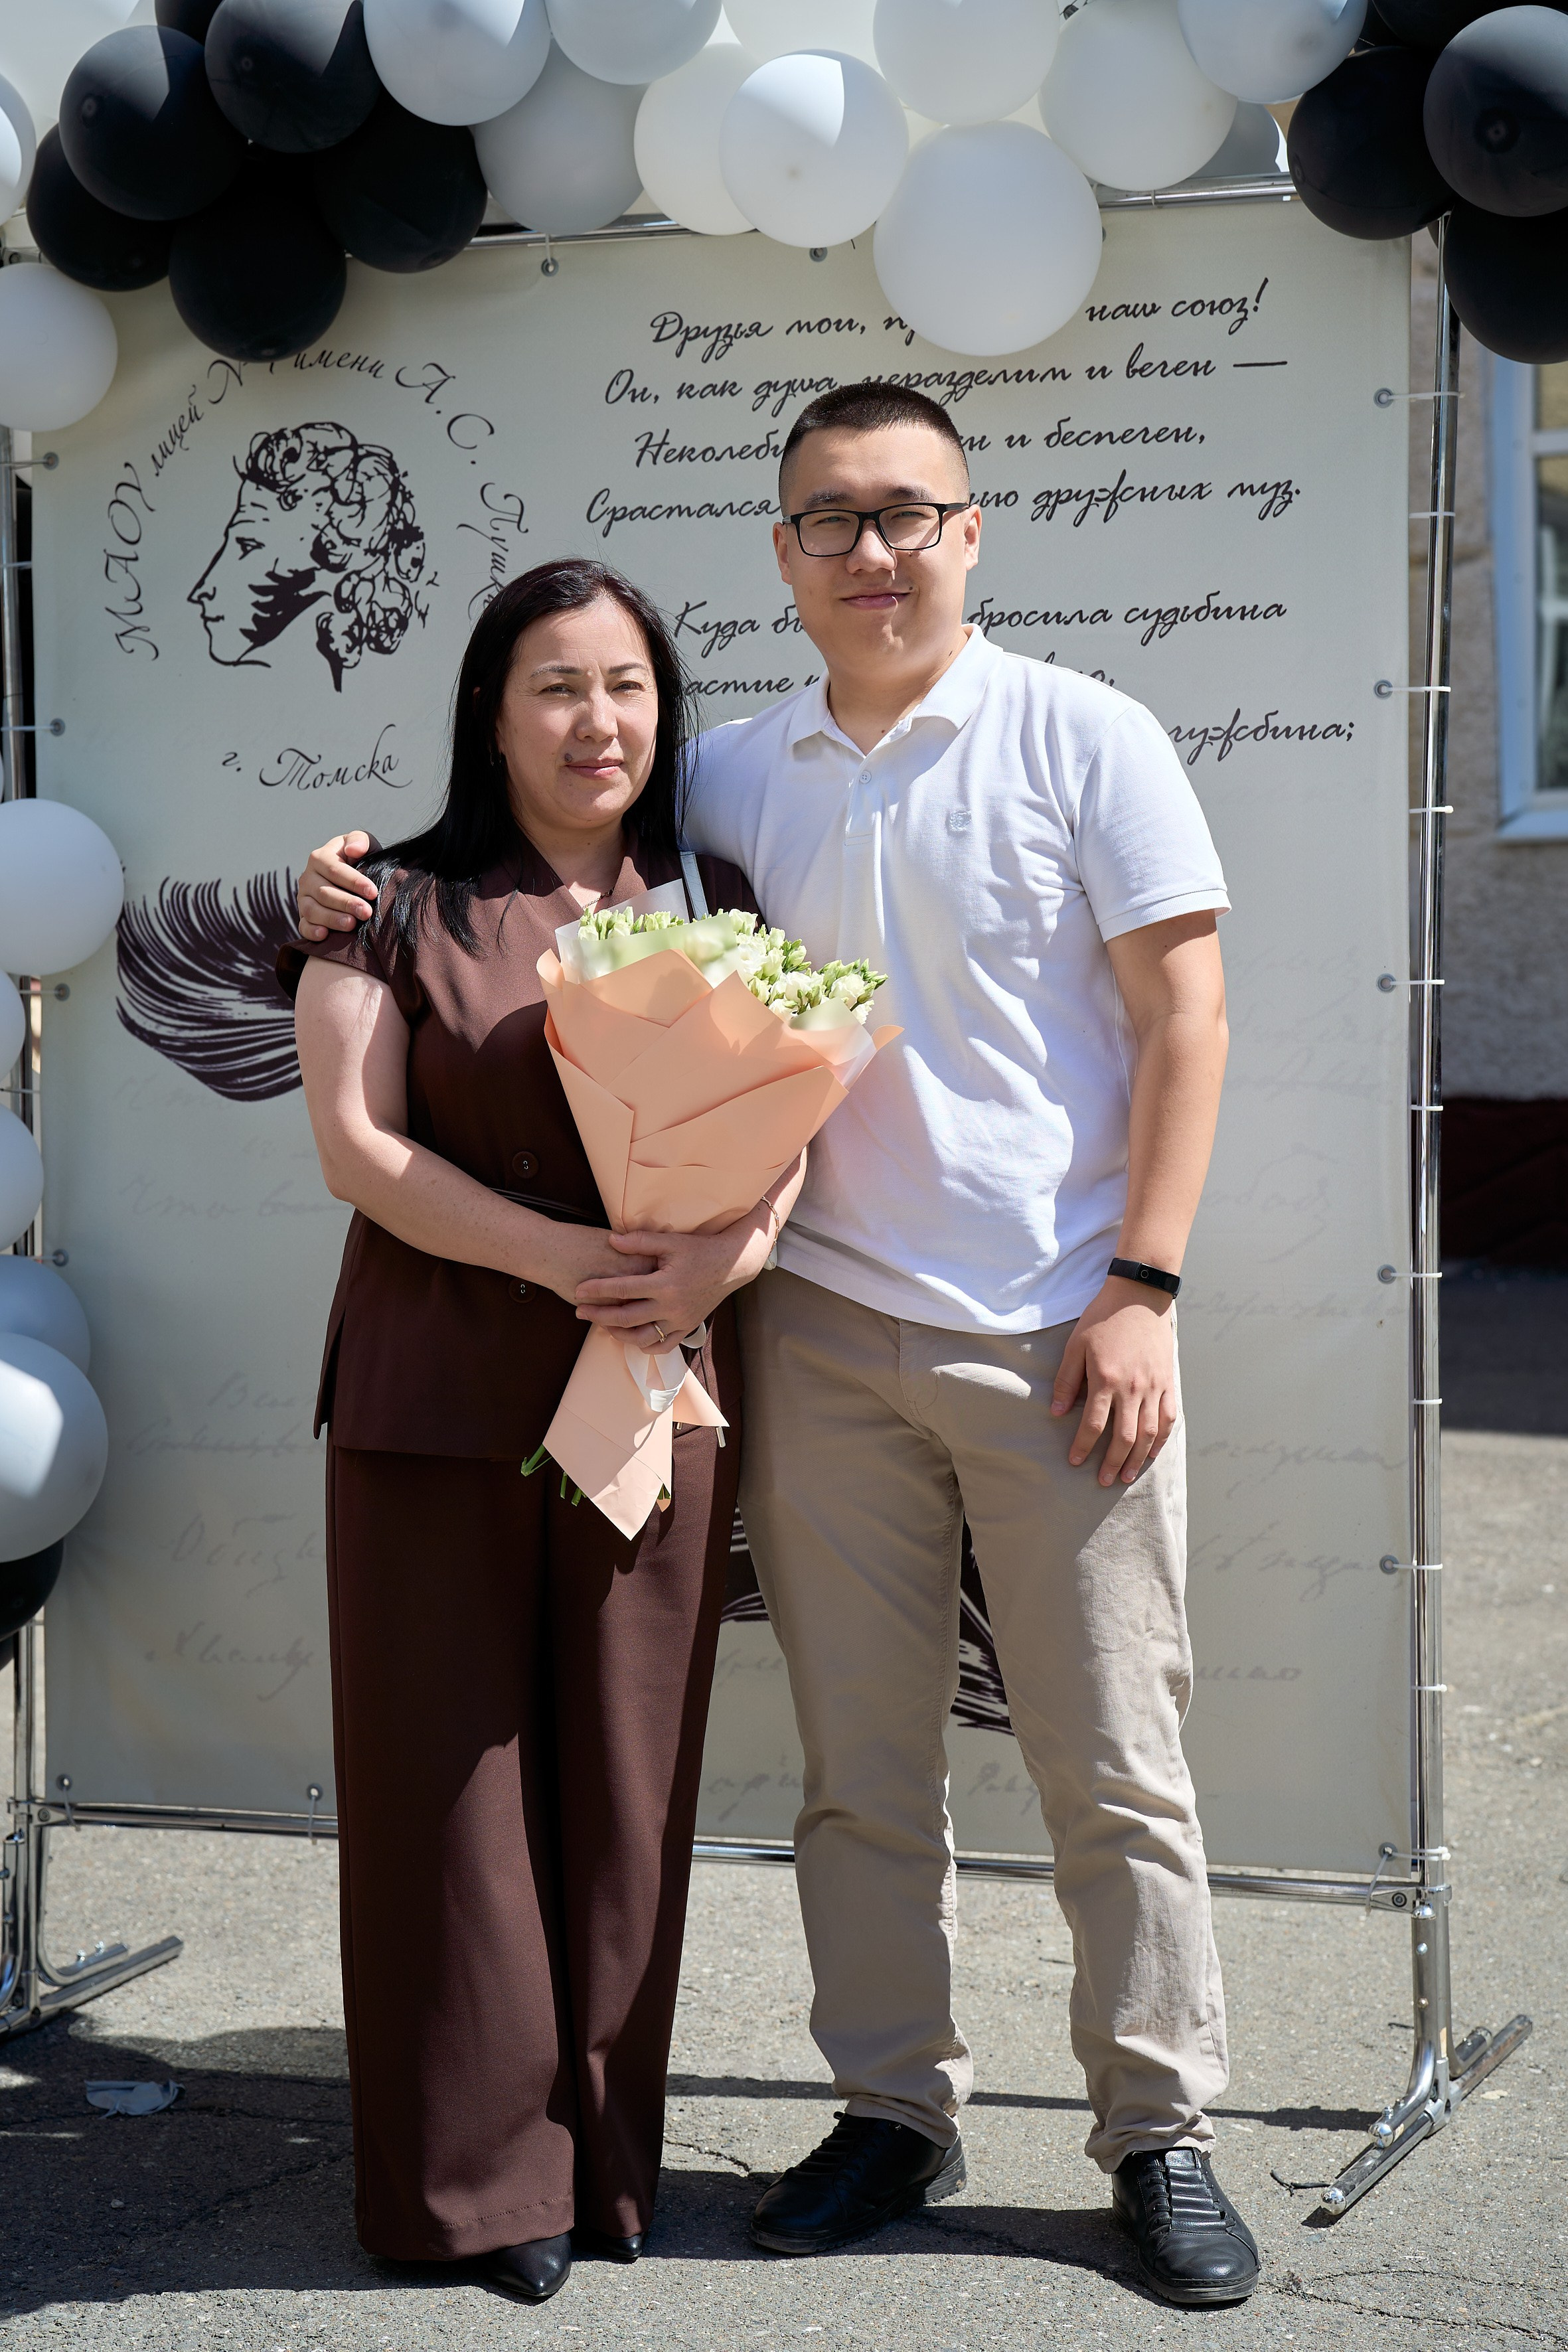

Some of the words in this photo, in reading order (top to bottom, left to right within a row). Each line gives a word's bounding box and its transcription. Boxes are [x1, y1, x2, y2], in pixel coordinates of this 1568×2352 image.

[651, 312, 773, 363] Друзья
[786, 318, 865, 335] мои,
[1085, 303, 1161, 321] наш
[1172, 277, 1269, 335] союз!
[605, 369, 659, 404] Он,
[677, 380, 742, 399] как
[1085, 365, 1112, 380] и
[1126, 343, 1215, 378] вечен
[635, 429, 785, 467] Неколеби
[1005, 435, 1031, 449] и
[1044, 417, 1204, 447] беспечен,
[104, 462, 157, 661] МАОУ
[150, 384, 204, 477] лицей
[294, 350, 385, 378] имени
[587, 489, 781, 538] Срастался
[1031, 469, 1212, 527] дружных
[1227, 480, 1300, 520] муз.
[674, 601, 759, 658] Куда
[1125, 591, 1287, 646] судьбина
[221, 751, 242, 773] г.
[259, 724, 412, 790] Томска
